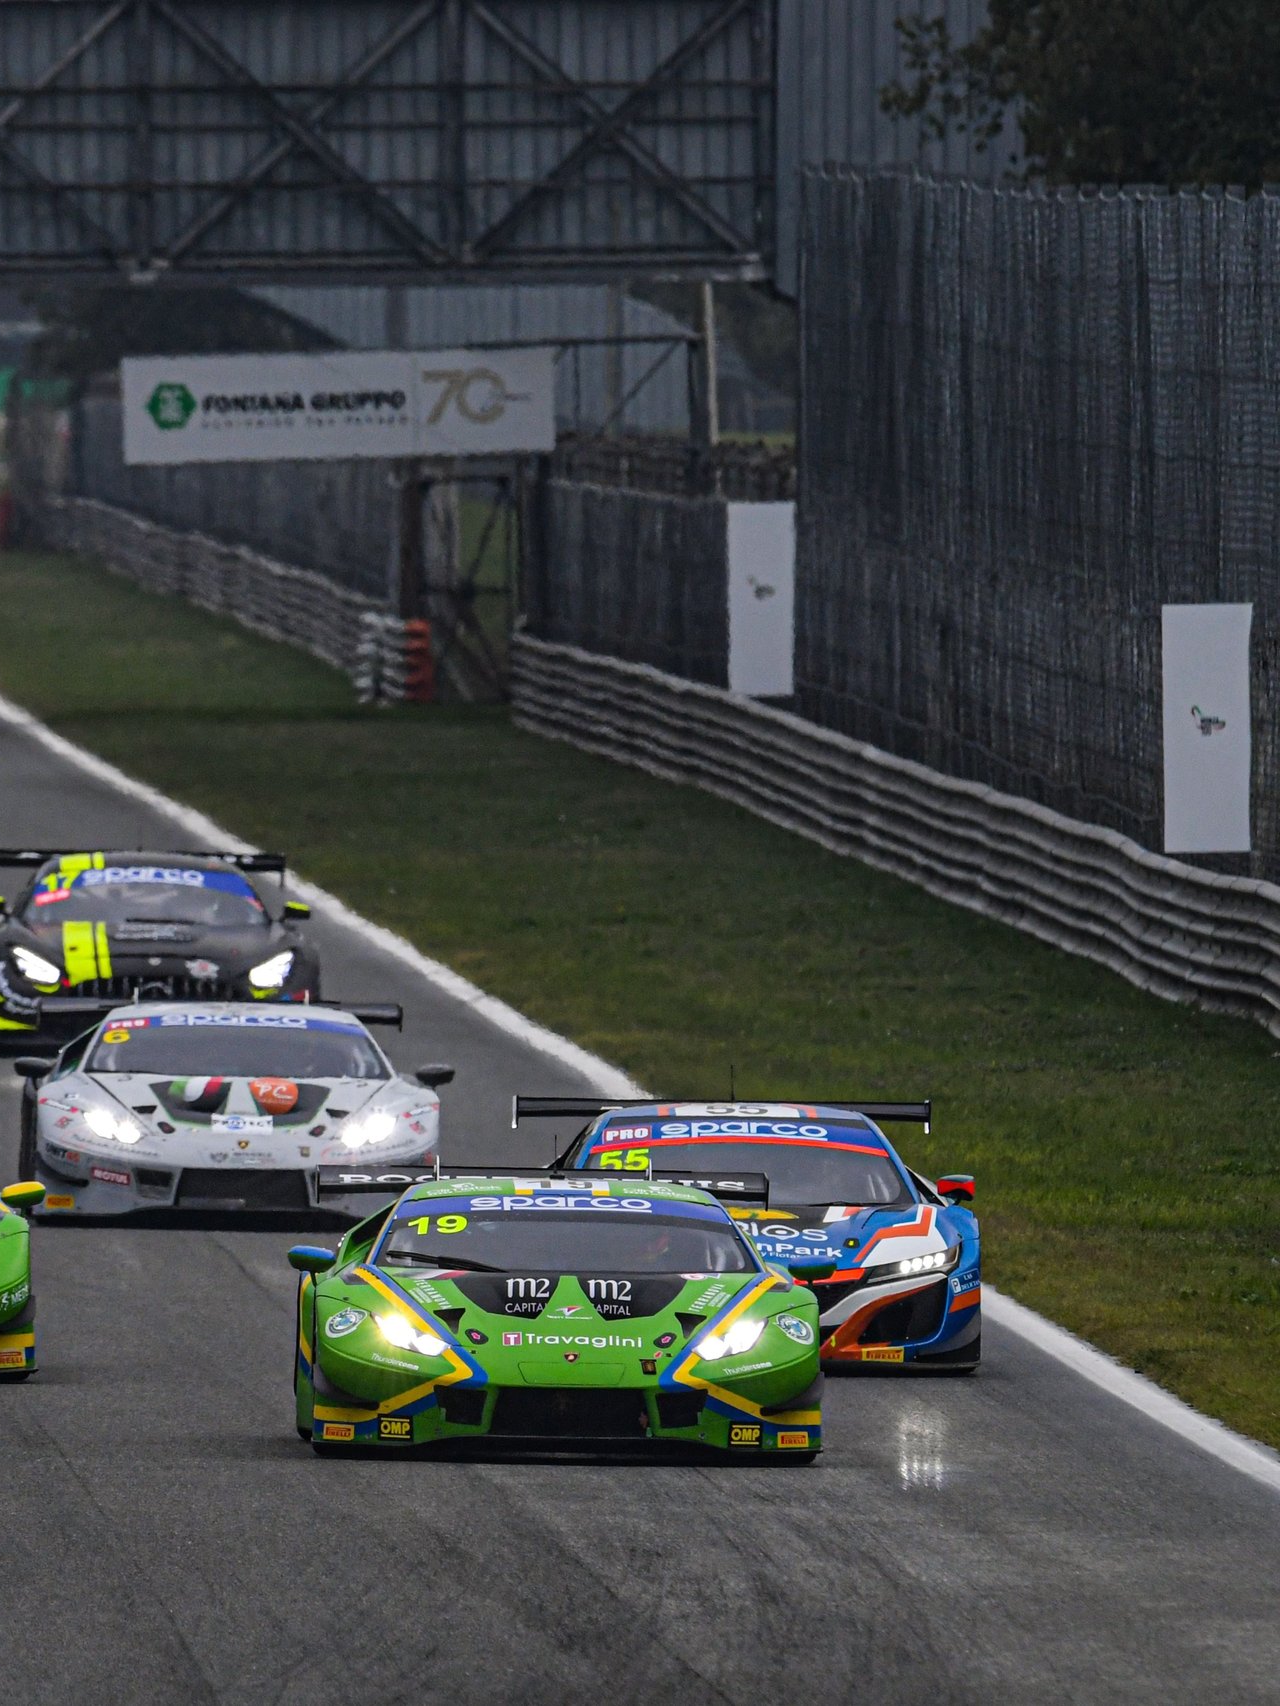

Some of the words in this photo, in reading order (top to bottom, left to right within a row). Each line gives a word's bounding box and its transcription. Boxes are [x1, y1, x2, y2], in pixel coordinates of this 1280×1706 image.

[202, 396, 305, 415] FONTANA
[310, 390, 407, 412] GRUPPO
[82, 867, 205, 887] sparco
[111, 1018, 146, 1029] PRO
[161, 1015, 308, 1029] sparco
[103, 1030, 131, 1044] 6
[606, 1128, 649, 1140] PRO
[661, 1121, 828, 1141] sparco
[600, 1149, 649, 1170] 55
[94, 1168, 128, 1185] MOTUL
[470, 1196, 652, 1213] sparco
[408, 1215, 467, 1235] 19
[506, 1277, 550, 1299] m2
[588, 1279, 632, 1301] m2
[592, 1304, 631, 1316] APITAL
[525, 1333, 642, 1348] Travaglini
[372, 1353, 419, 1371] Thundercomm
[723, 1361, 772, 1375] Thundercomm
[380, 1421, 410, 1434] OMP
[731, 1428, 760, 1441] OMP
